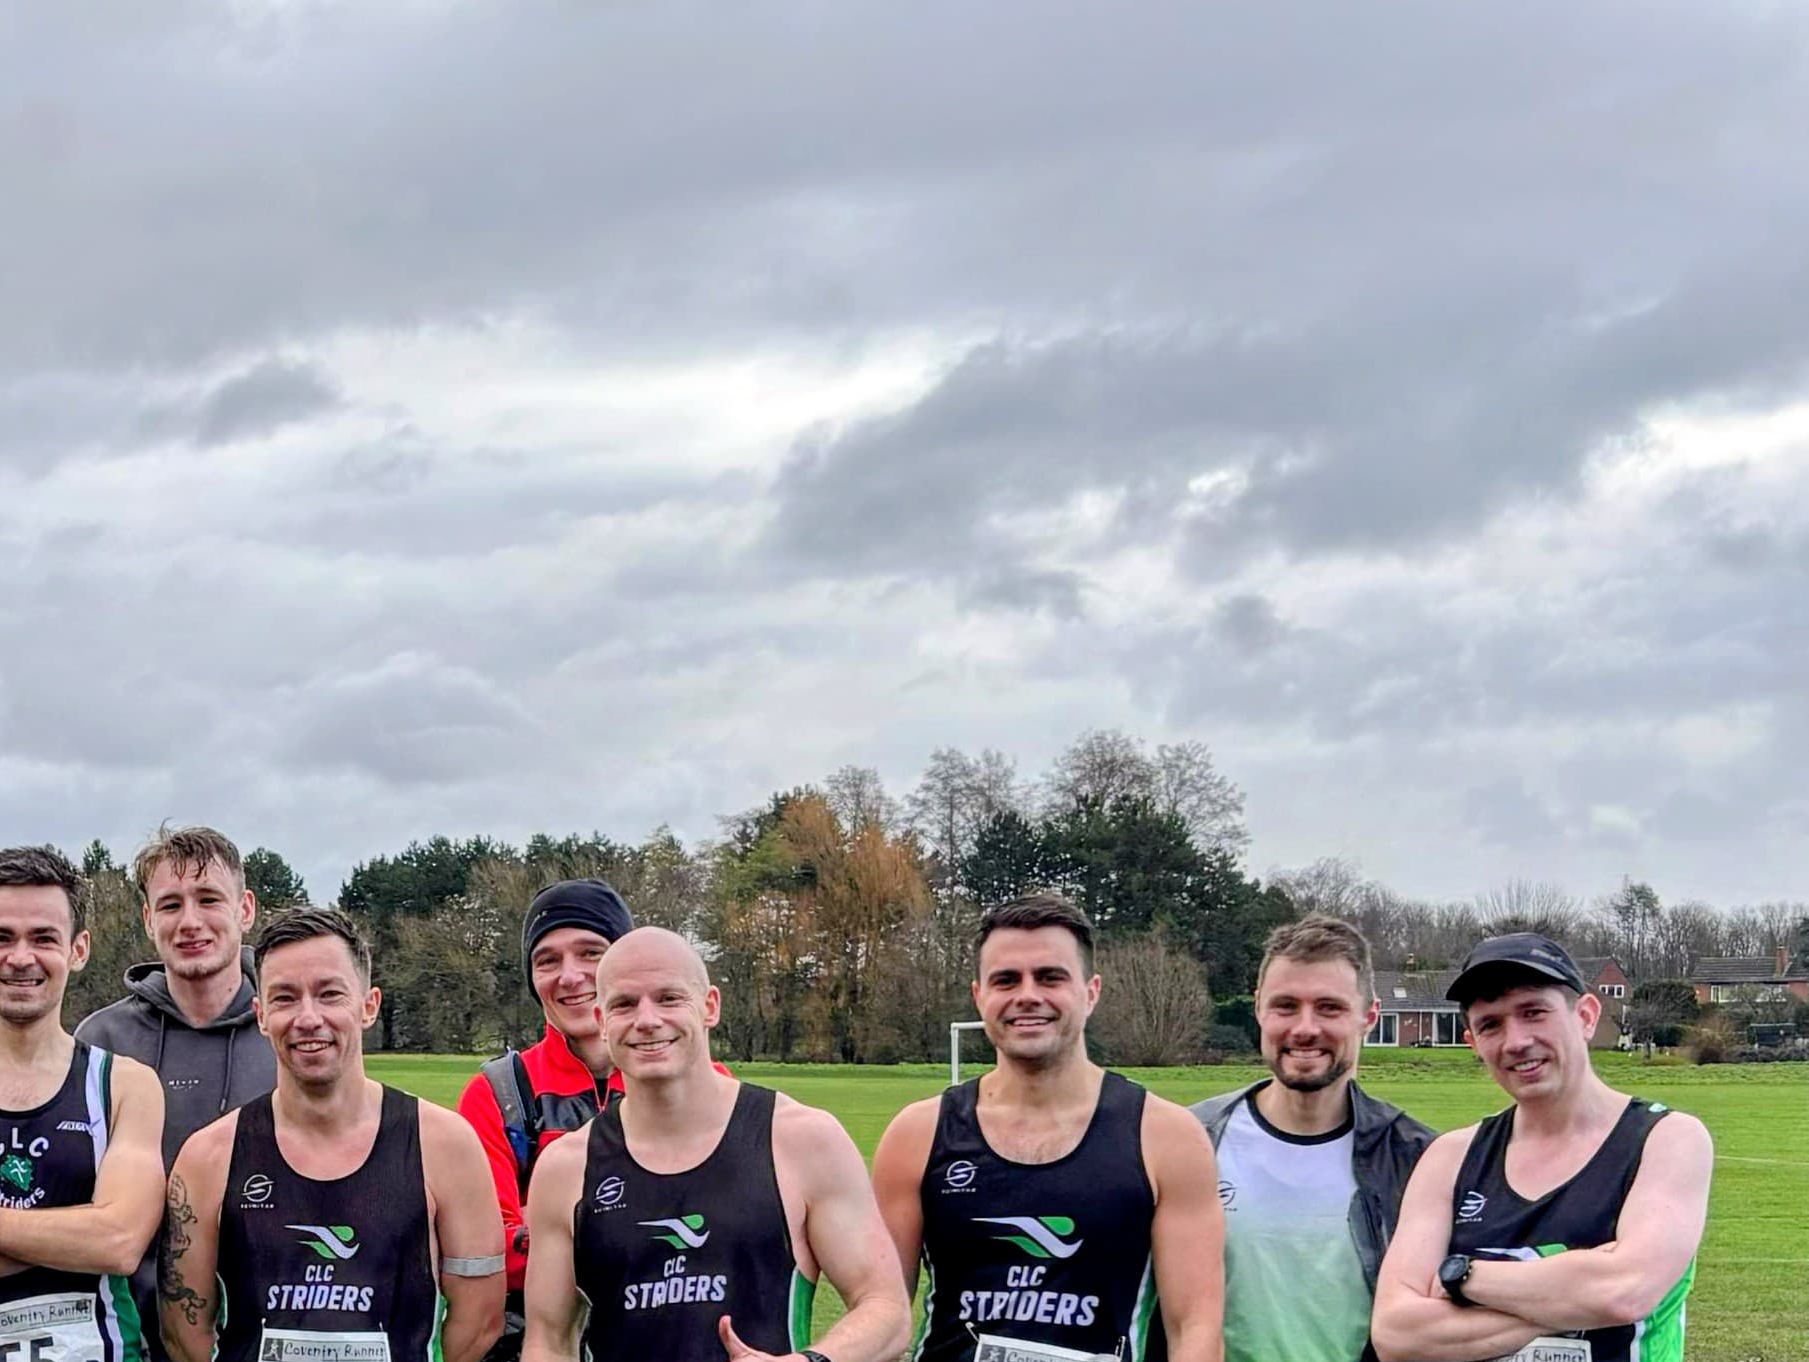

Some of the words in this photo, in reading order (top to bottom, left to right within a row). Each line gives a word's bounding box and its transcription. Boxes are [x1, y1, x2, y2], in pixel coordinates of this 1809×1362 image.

[304, 1265, 335, 1282] CLC
[1007, 1265, 1046, 1288] CLC
[266, 1285, 374, 1312] STRIDERS
[624, 1275, 728, 1311] STRIDERS
[959, 1290, 1099, 1326] STRIDERS
[284, 1343, 339, 1362] Coventry
[345, 1344, 384, 1357] Runner
